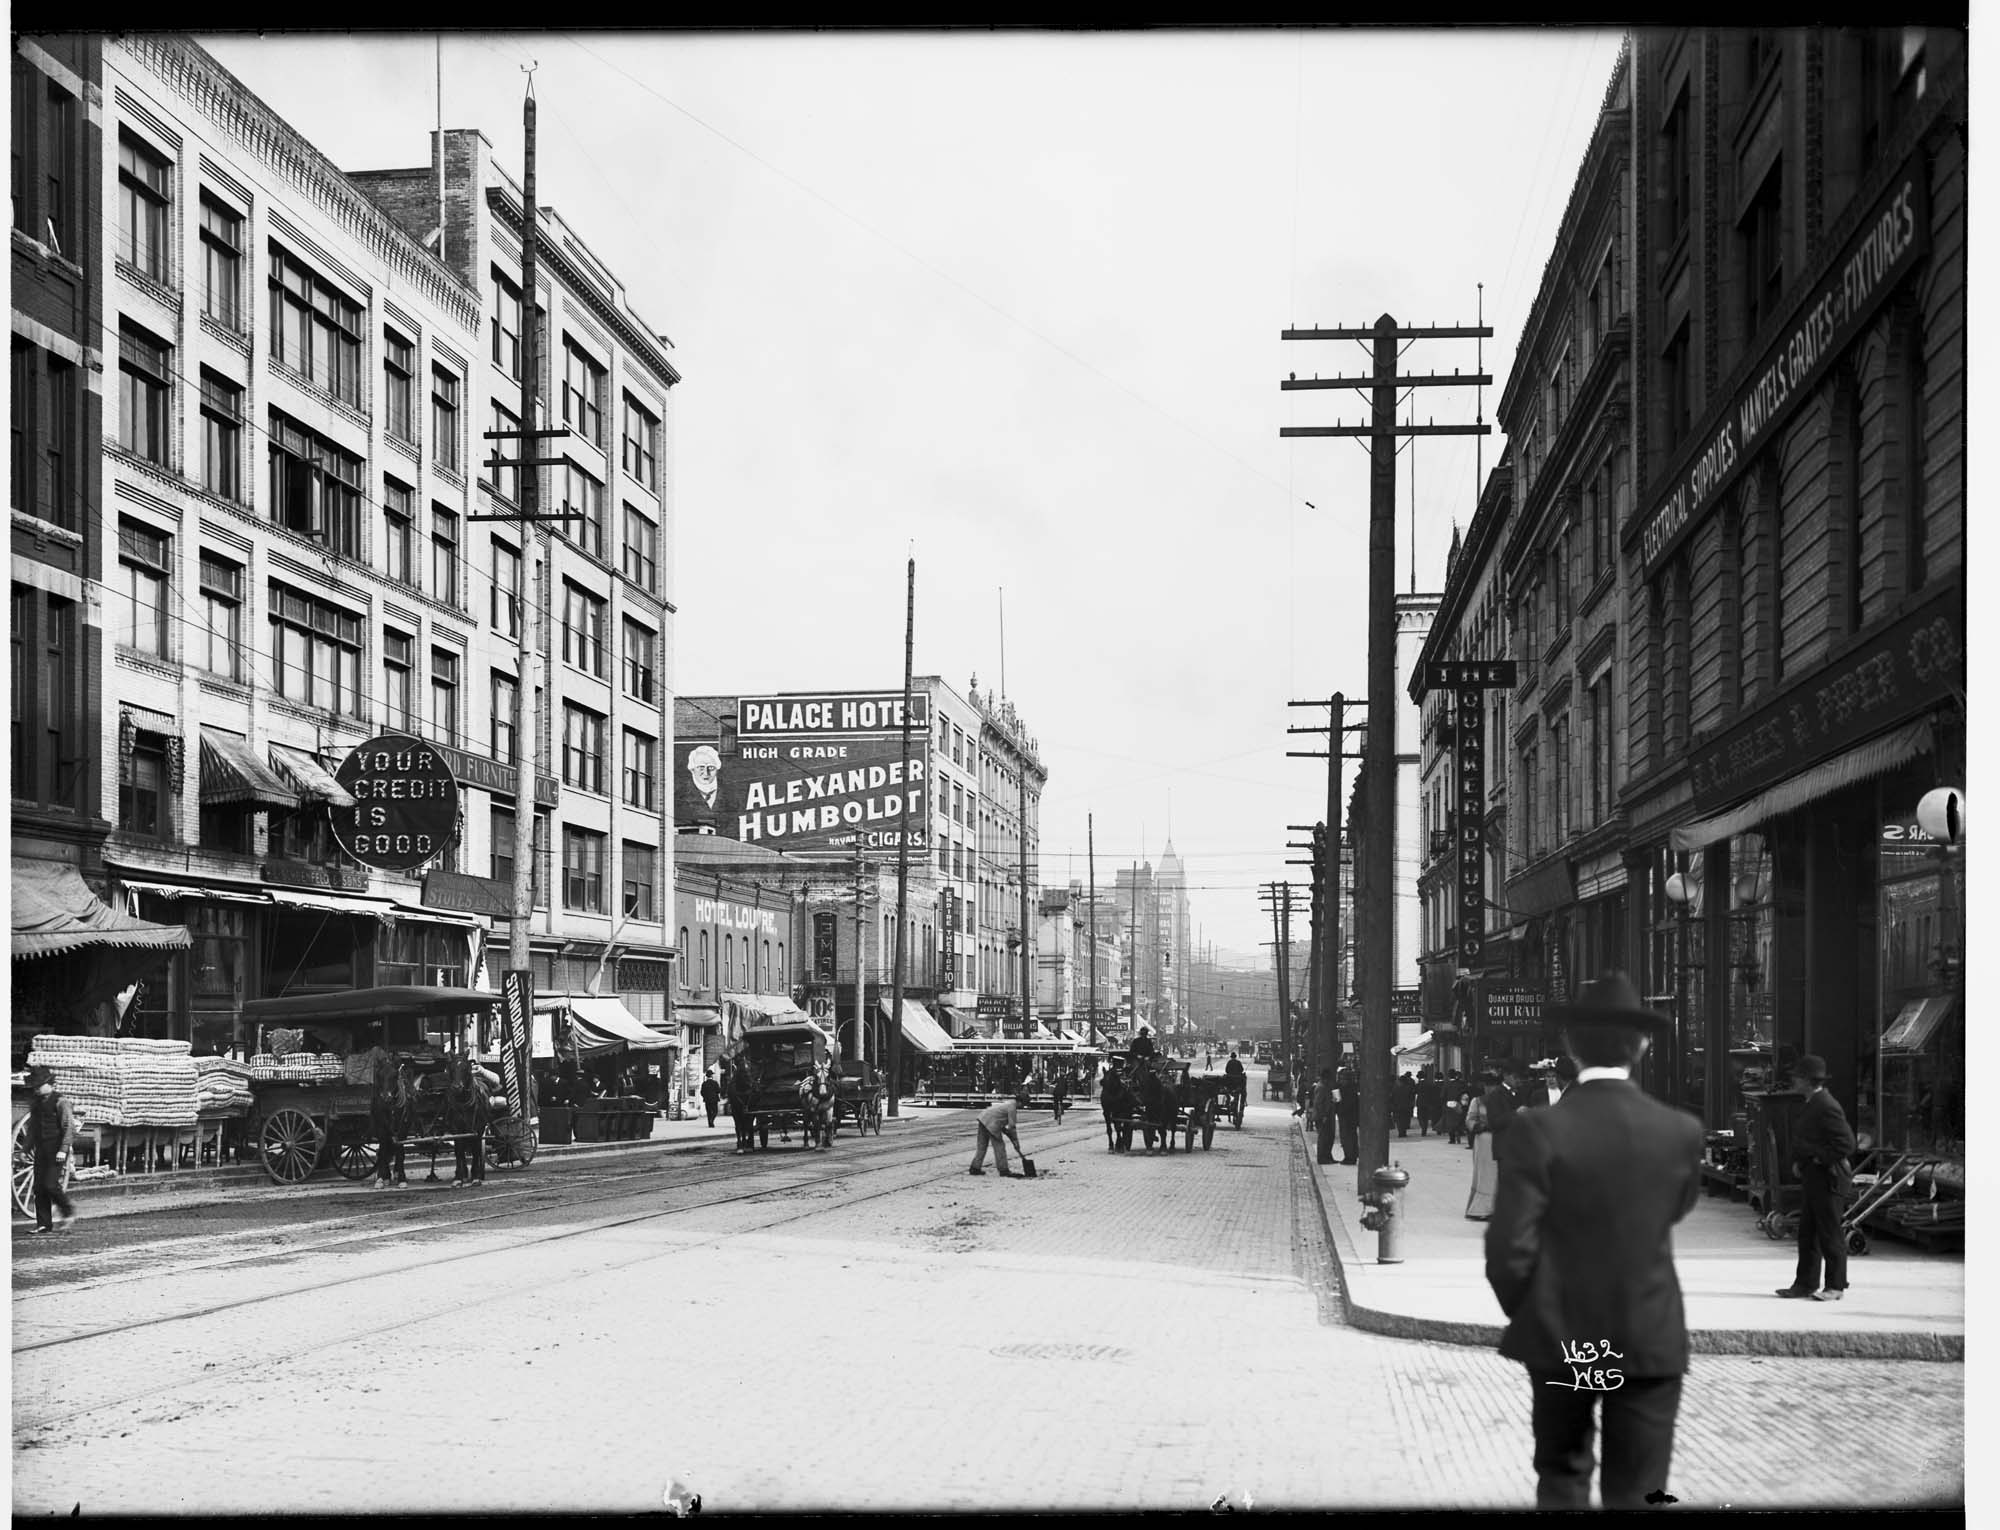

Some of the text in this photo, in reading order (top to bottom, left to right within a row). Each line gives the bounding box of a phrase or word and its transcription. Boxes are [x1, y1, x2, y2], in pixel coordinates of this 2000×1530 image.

[1643, 482, 1689, 566] ELECTRICAL
[1787, 290, 1833, 390] GRATES
[1843, 180, 1914, 324] FIXTURES
[1435, 666, 1504, 683] THE
[746, 702, 834, 730] PALACE
[356, 751, 434, 772] YOUR
[742, 746, 848, 759] HIGH GRADE
[1462, 691, 1481, 815] QUAKER
[354, 779, 450, 799] CREDIT
[745, 759, 925, 811] ALEXANDER
[354, 806, 387, 827] IS
[738, 789, 922, 843] HUMBOLDT
[354, 834, 432, 854] GOOD
[828, 834, 857, 846] HAVAN
[1462, 826, 1481, 907] DRUG
[695, 897, 733, 928] HOTEL
[1487, 993, 1515, 1004] QUAKER
[505, 971, 526, 1049] STANDARD
[1488, 1005, 1510, 1017] CUT
